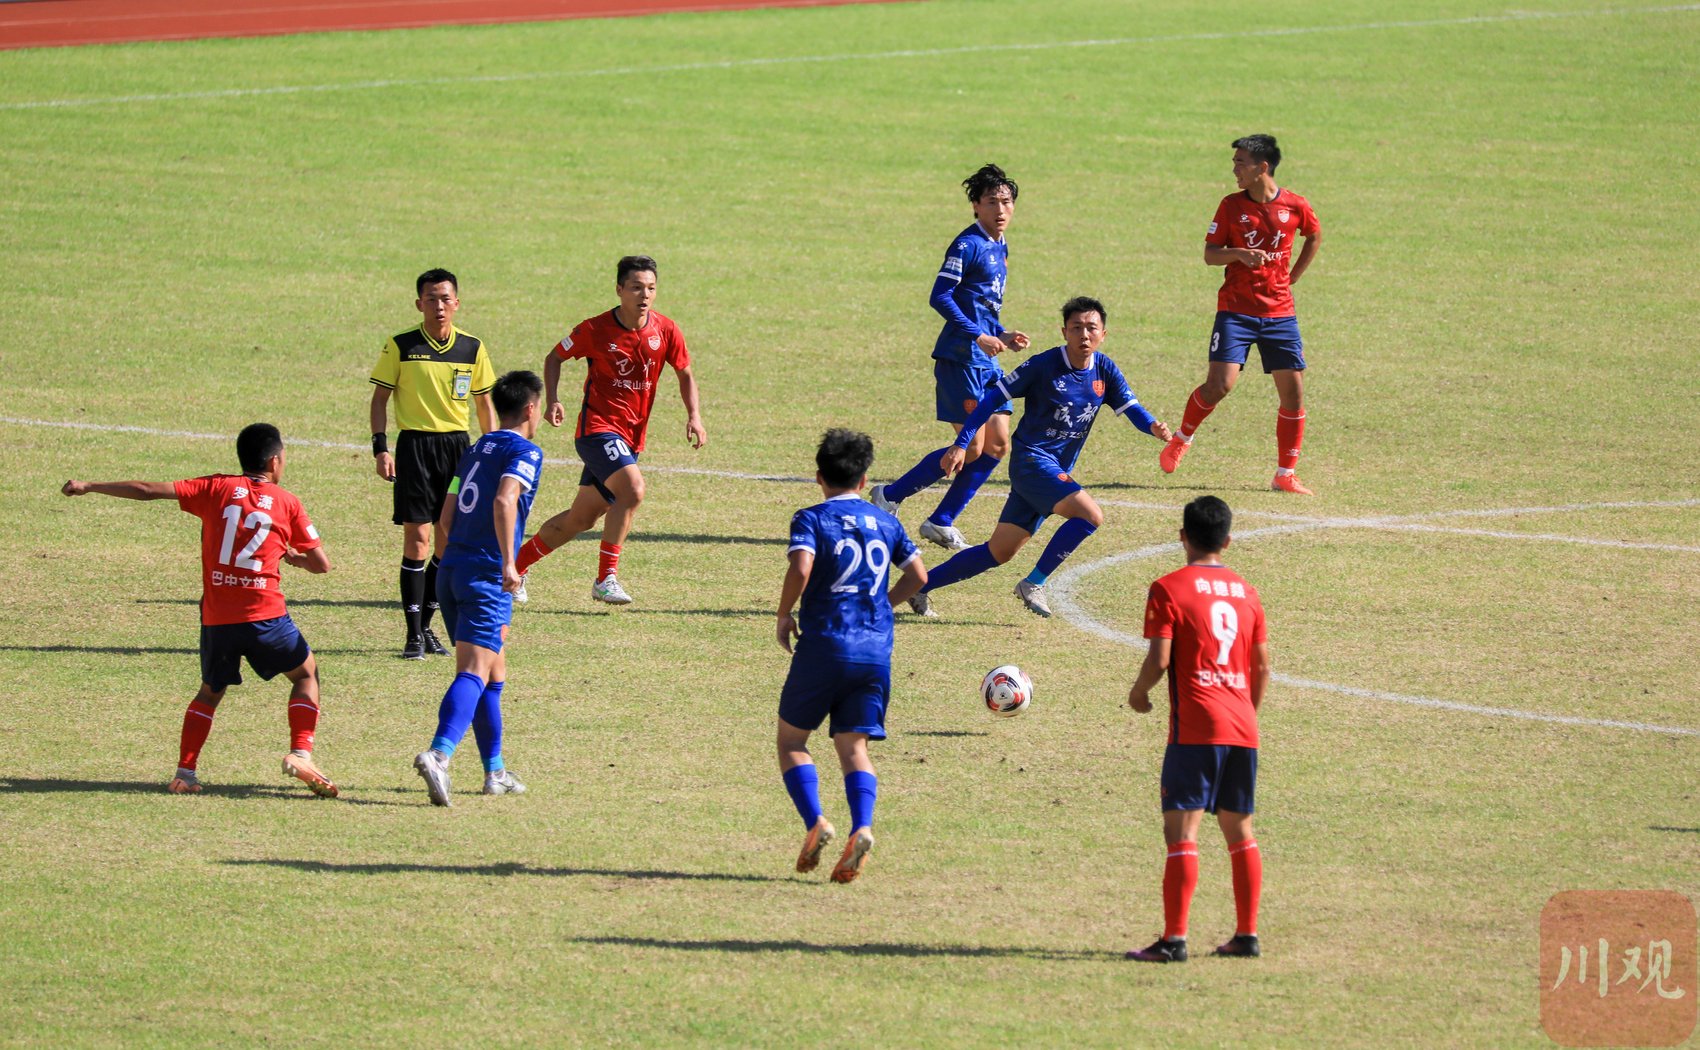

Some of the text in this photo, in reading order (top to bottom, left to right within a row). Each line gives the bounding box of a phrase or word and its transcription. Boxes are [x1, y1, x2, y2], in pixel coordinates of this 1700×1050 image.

[1210, 332, 1220, 352] 3
[603, 438, 631, 462] 50
[458, 461, 480, 514] 6
[218, 504, 273, 572] 12
[212, 570, 268, 589] 巴中文旅
[830, 537, 891, 597] 29
[1210, 600, 1238, 665] 9
